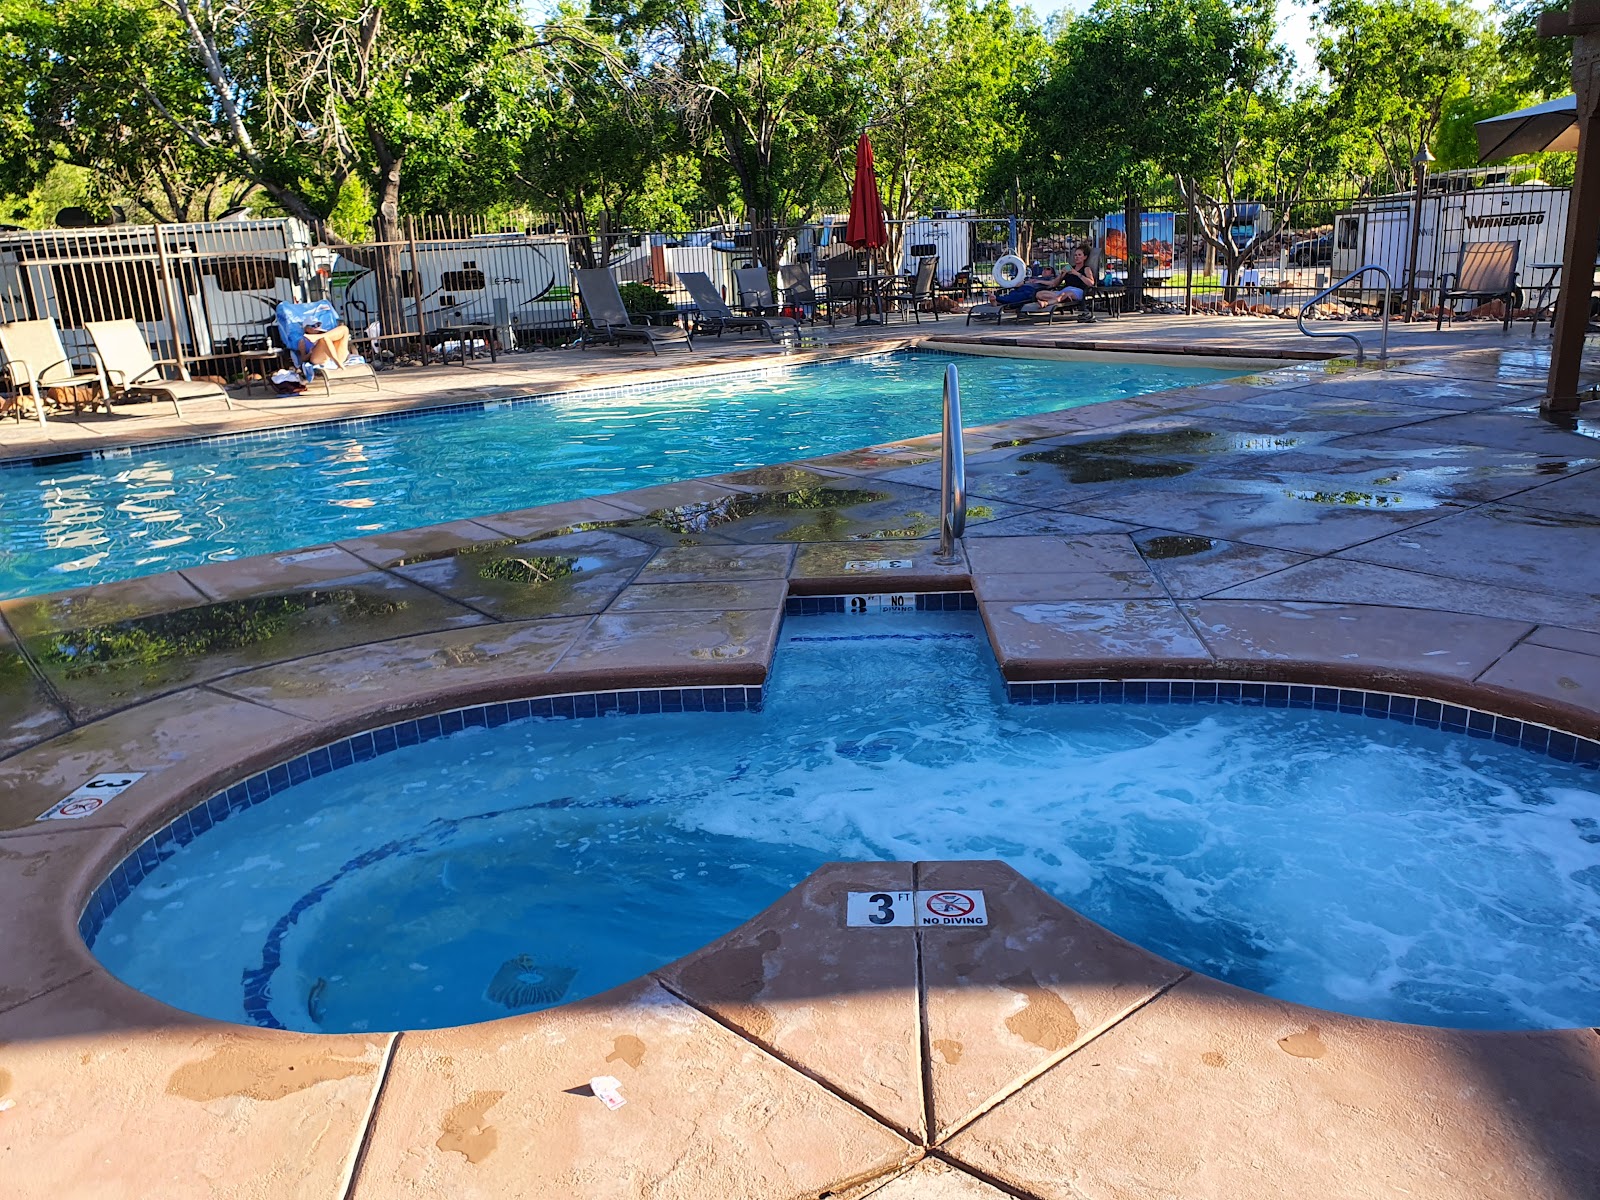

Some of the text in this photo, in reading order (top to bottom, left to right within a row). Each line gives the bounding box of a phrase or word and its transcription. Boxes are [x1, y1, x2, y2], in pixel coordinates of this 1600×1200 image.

[1464, 213, 1545, 229] WINNEBAGO
[891, 595, 904, 606] NO
[868, 893, 910, 925] 3 FT
[923, 917, 984, 925] NO DIVING
